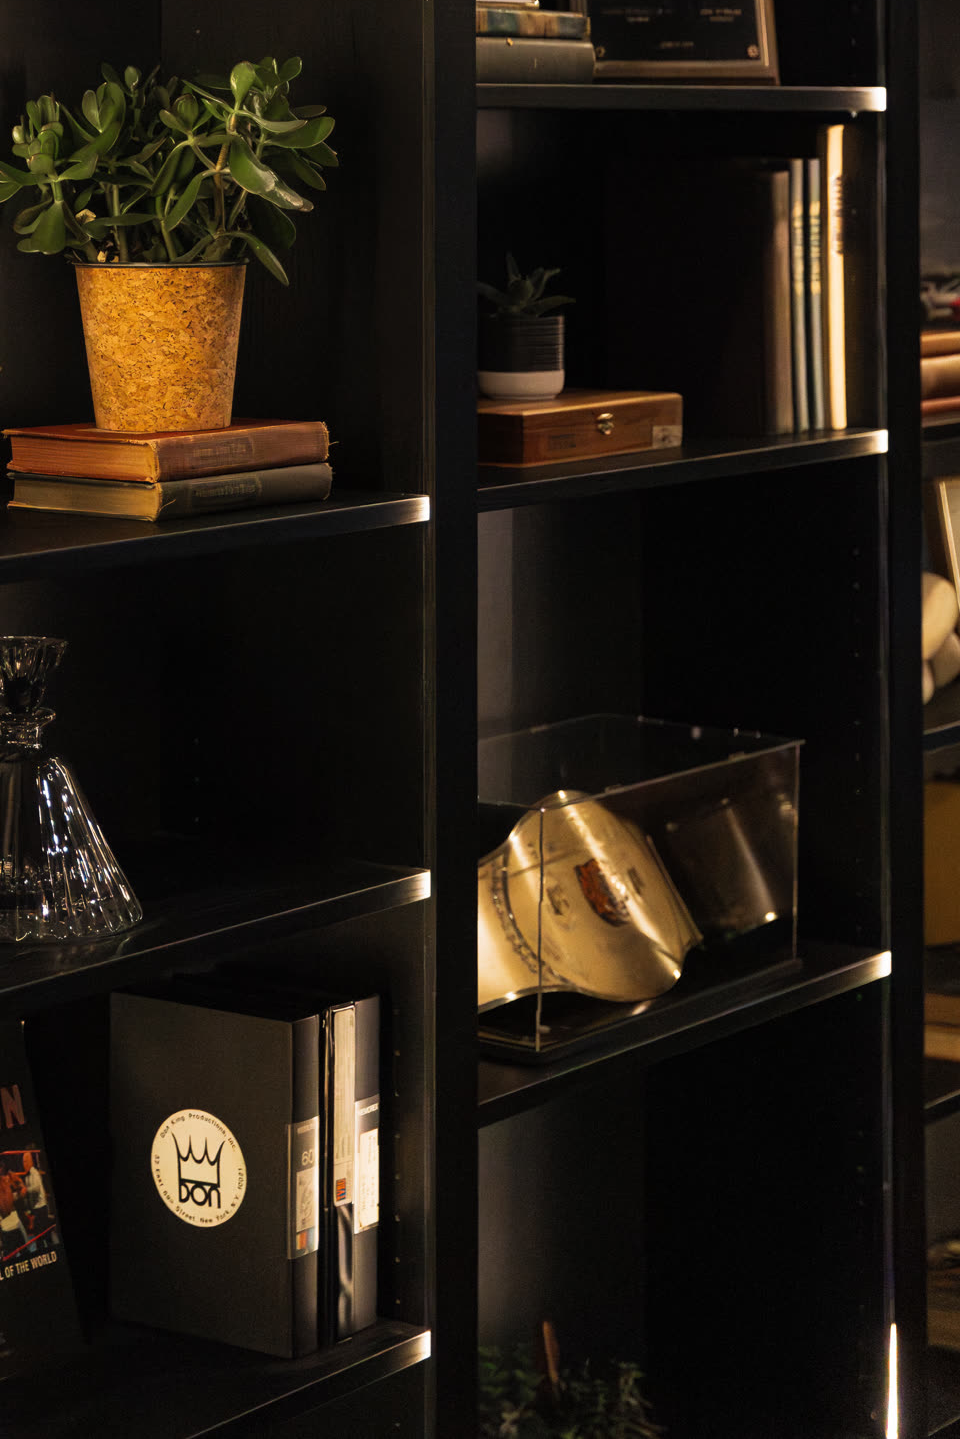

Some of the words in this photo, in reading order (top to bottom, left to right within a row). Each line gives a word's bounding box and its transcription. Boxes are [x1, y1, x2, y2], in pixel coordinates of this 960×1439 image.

[171, 1116, 186, 1125] King
[301, 1151, 315, 1166] 60
[175, 1206, 196, 1222] Street
[5, 1266, 15, 1279] OF
[15, 1260, 30, 1275] THE
[30, 1251, 57, 1270] WORLD
